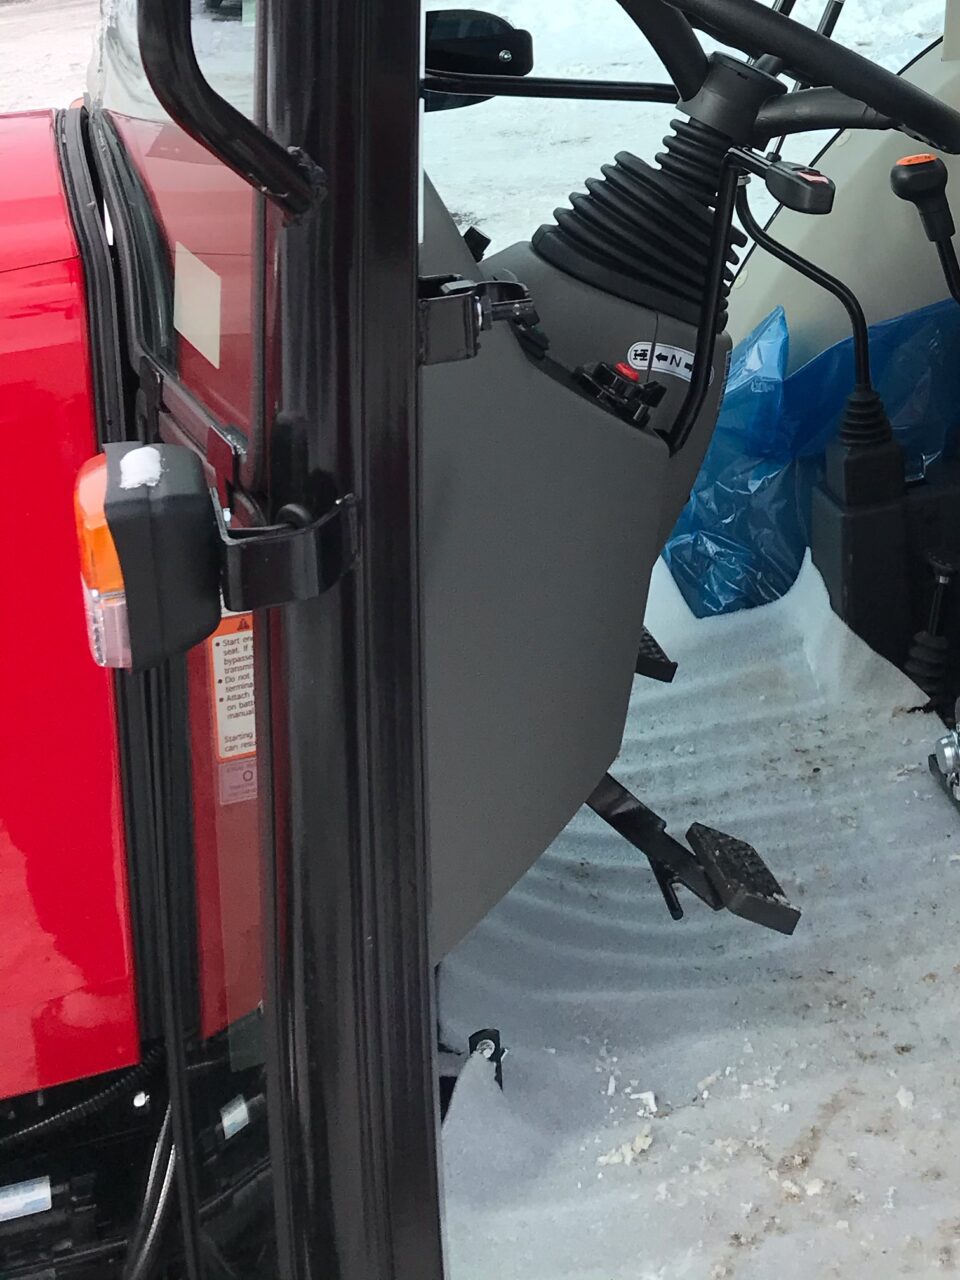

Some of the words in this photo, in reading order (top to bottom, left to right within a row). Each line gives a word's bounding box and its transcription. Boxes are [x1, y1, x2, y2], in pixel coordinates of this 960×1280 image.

[669, 354, 682, 368] N
[223, 638, 240, 646] Start
[224, 655, 253, 666] bypasse
[225, 676, 235, 684] Do
[238, 673, 249, 681] not
[225, 682, 253, 693] termina
[227, 692, 250, 702] Attach
[224, 732, 253, 743] Starting
[224, 744, 239, 752] can
